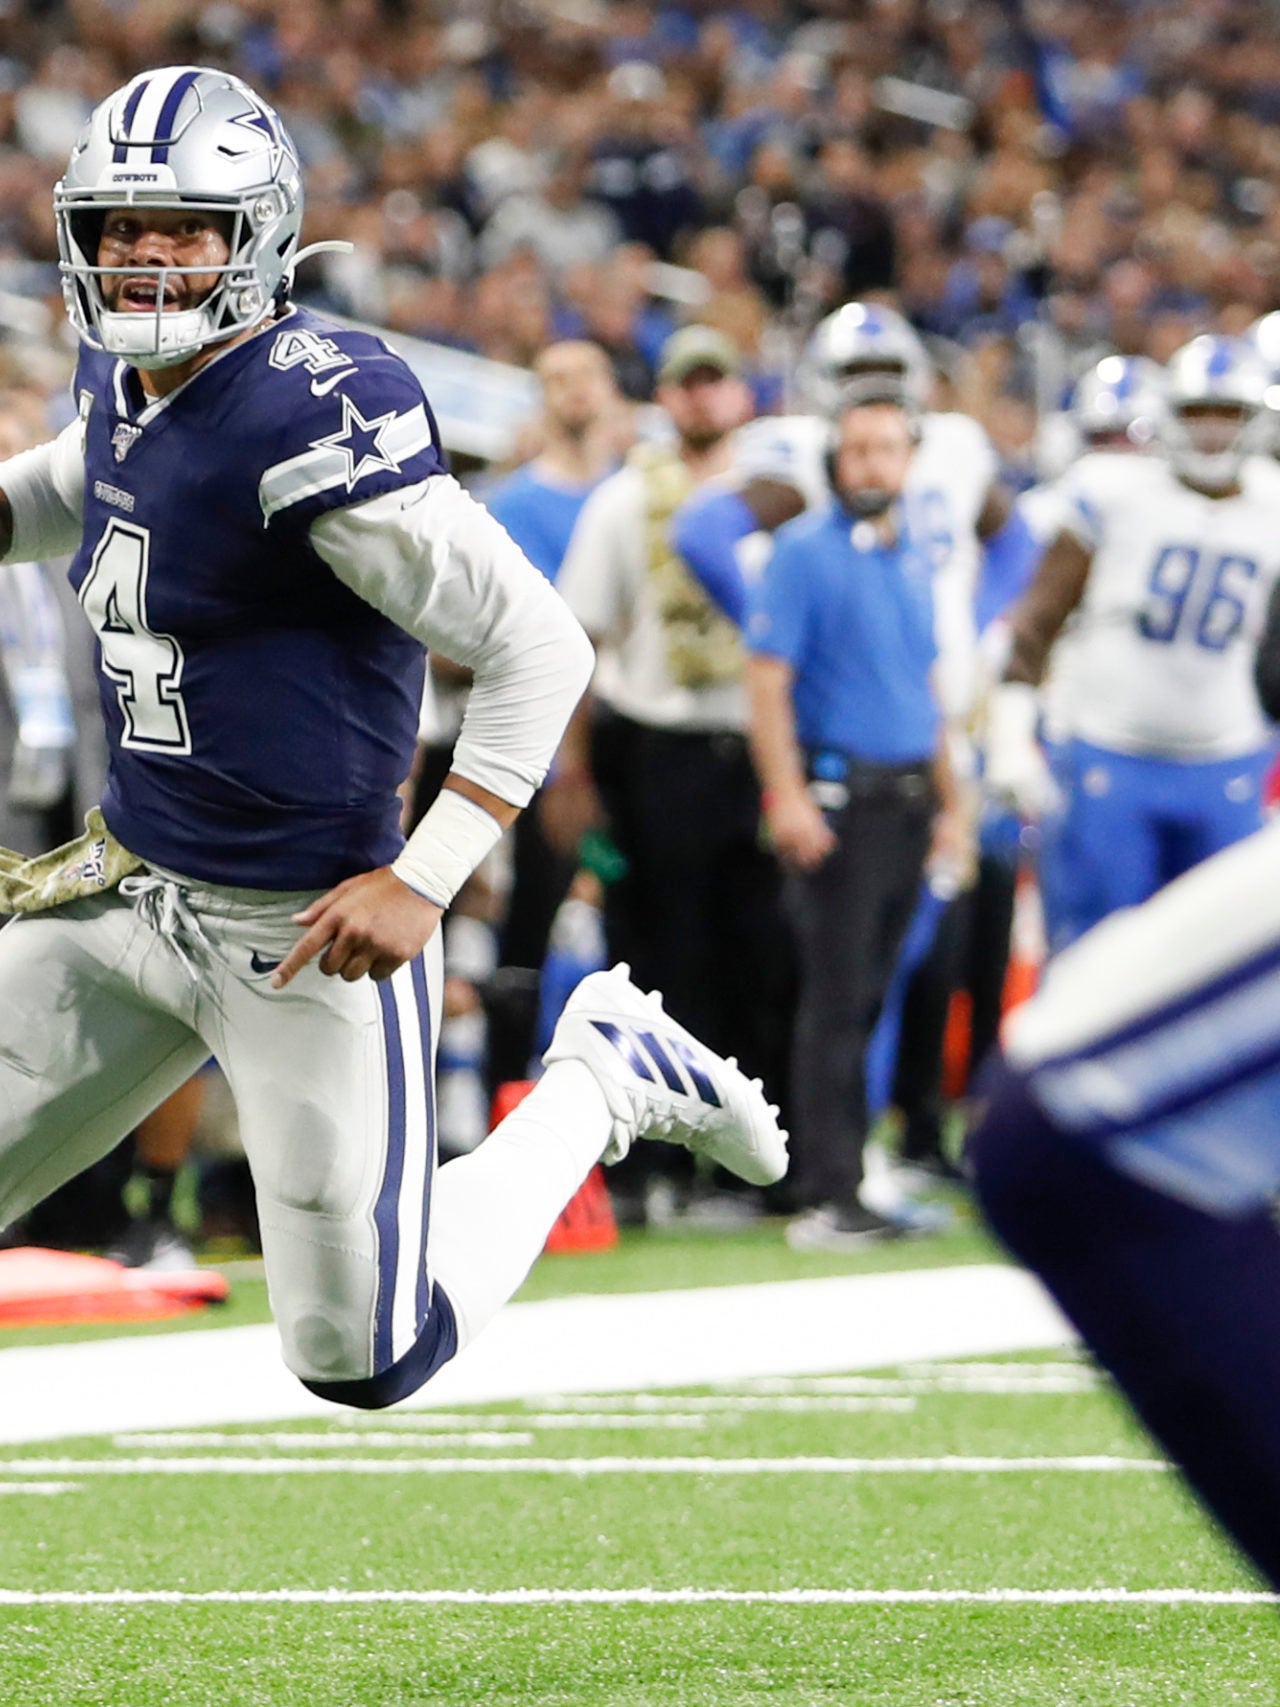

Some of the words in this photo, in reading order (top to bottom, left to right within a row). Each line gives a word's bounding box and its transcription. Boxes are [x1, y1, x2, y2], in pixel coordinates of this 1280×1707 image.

[268, 328, 354, 375] 4
[77, 515, 193, 756] 4
[1134, 545, 1258, 652] 96
